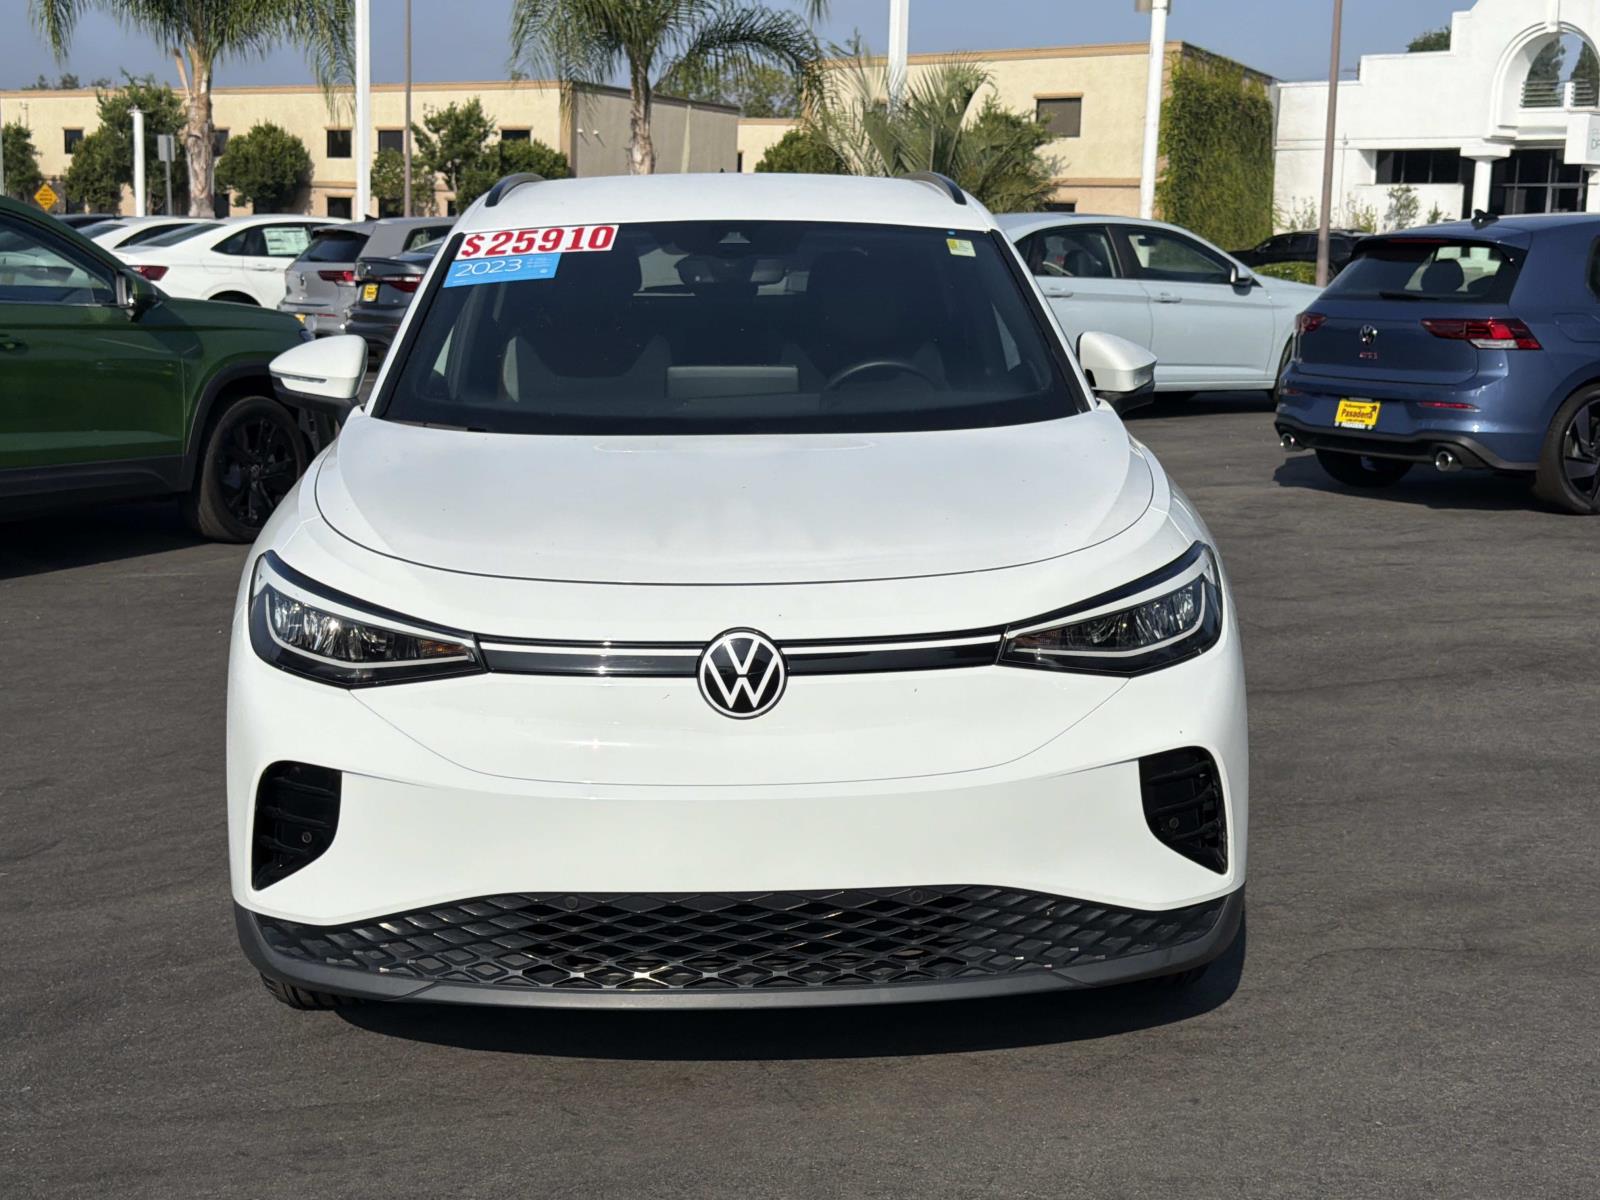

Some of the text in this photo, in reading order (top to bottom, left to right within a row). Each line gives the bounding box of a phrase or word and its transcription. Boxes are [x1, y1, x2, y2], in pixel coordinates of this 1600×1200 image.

[461, 226, 614, 257] $25910
[455, 258, 523, 277] 2023
[1341, 408, 1373, 419] Pasadena
[700, 633, 784, 715] VW
